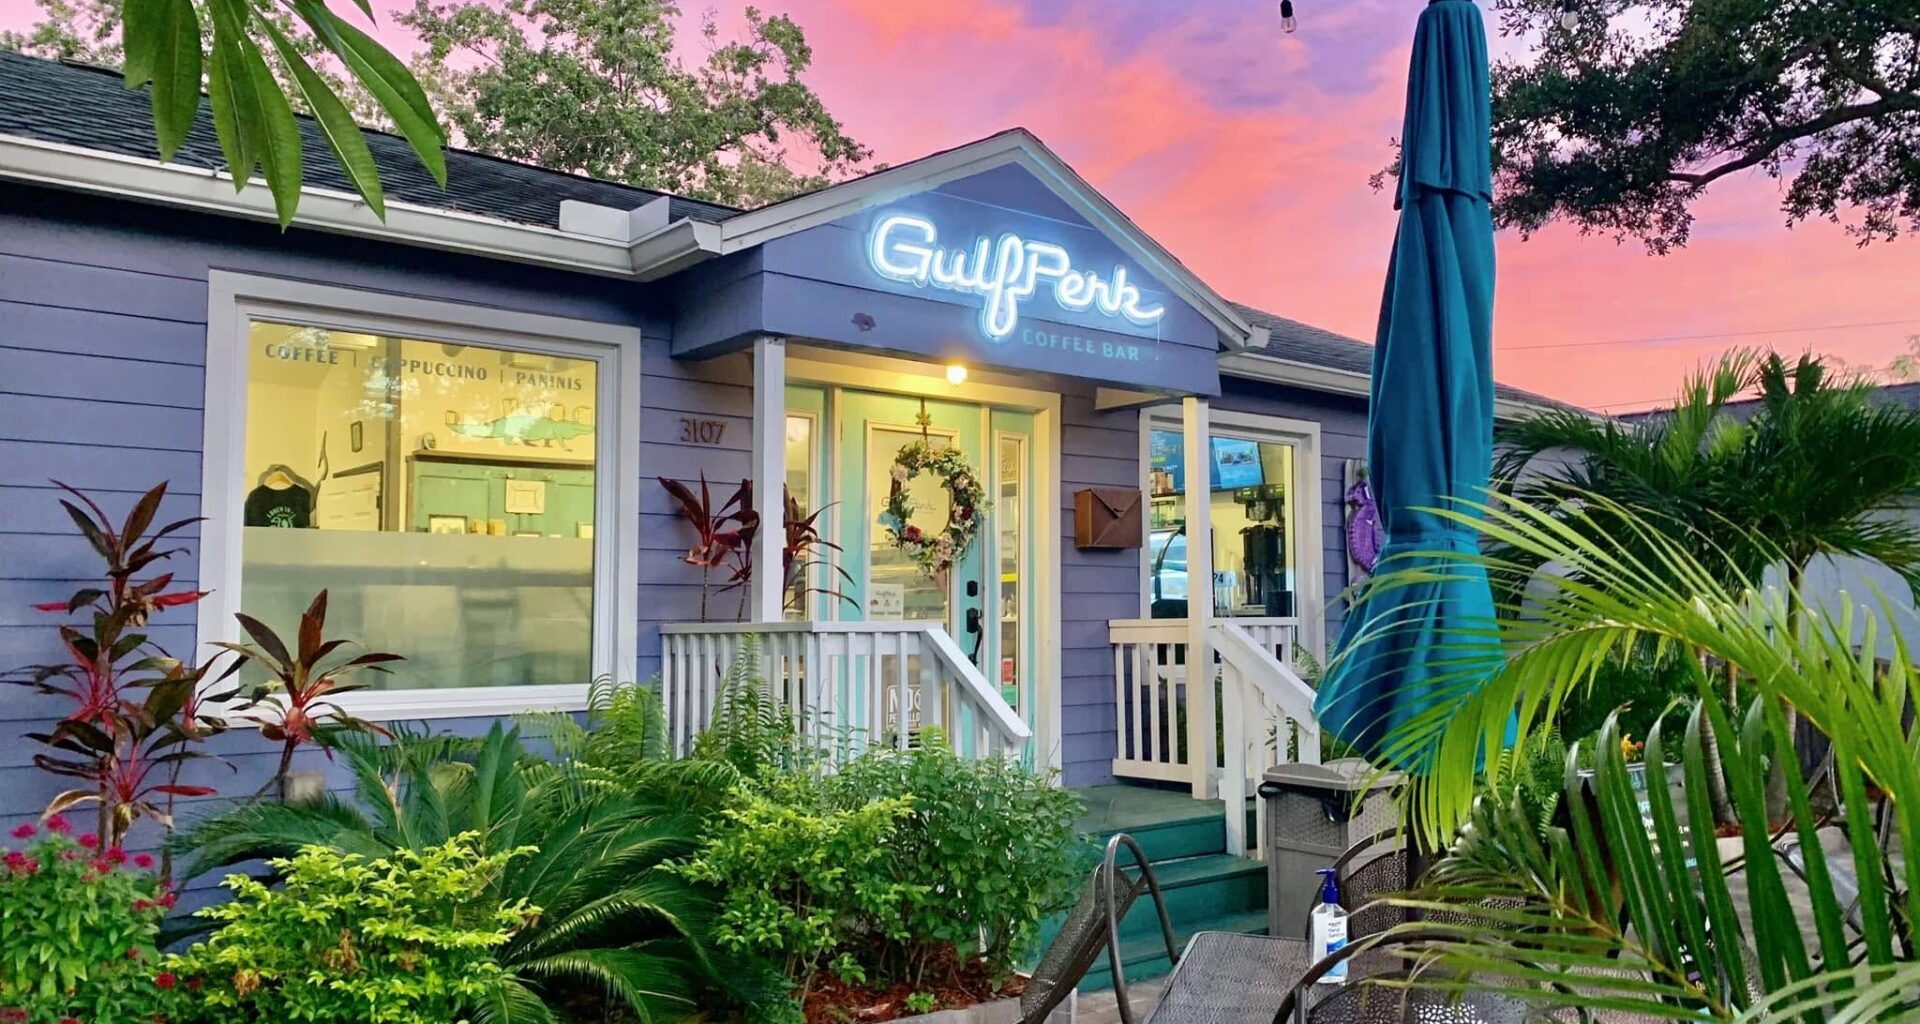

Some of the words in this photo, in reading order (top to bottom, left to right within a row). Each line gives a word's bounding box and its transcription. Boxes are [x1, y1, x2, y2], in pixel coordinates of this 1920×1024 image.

[1022, 329, 1096, 355] COFFEE
[1101, 341, 1139, 361] BAR
[265, 343, 339, 365] COFFEE
[371, 355, 488, 381] CPPUCCINO
[516, 371, 583, 392] PANINIS
[680, 417, 728, 445] 3107
